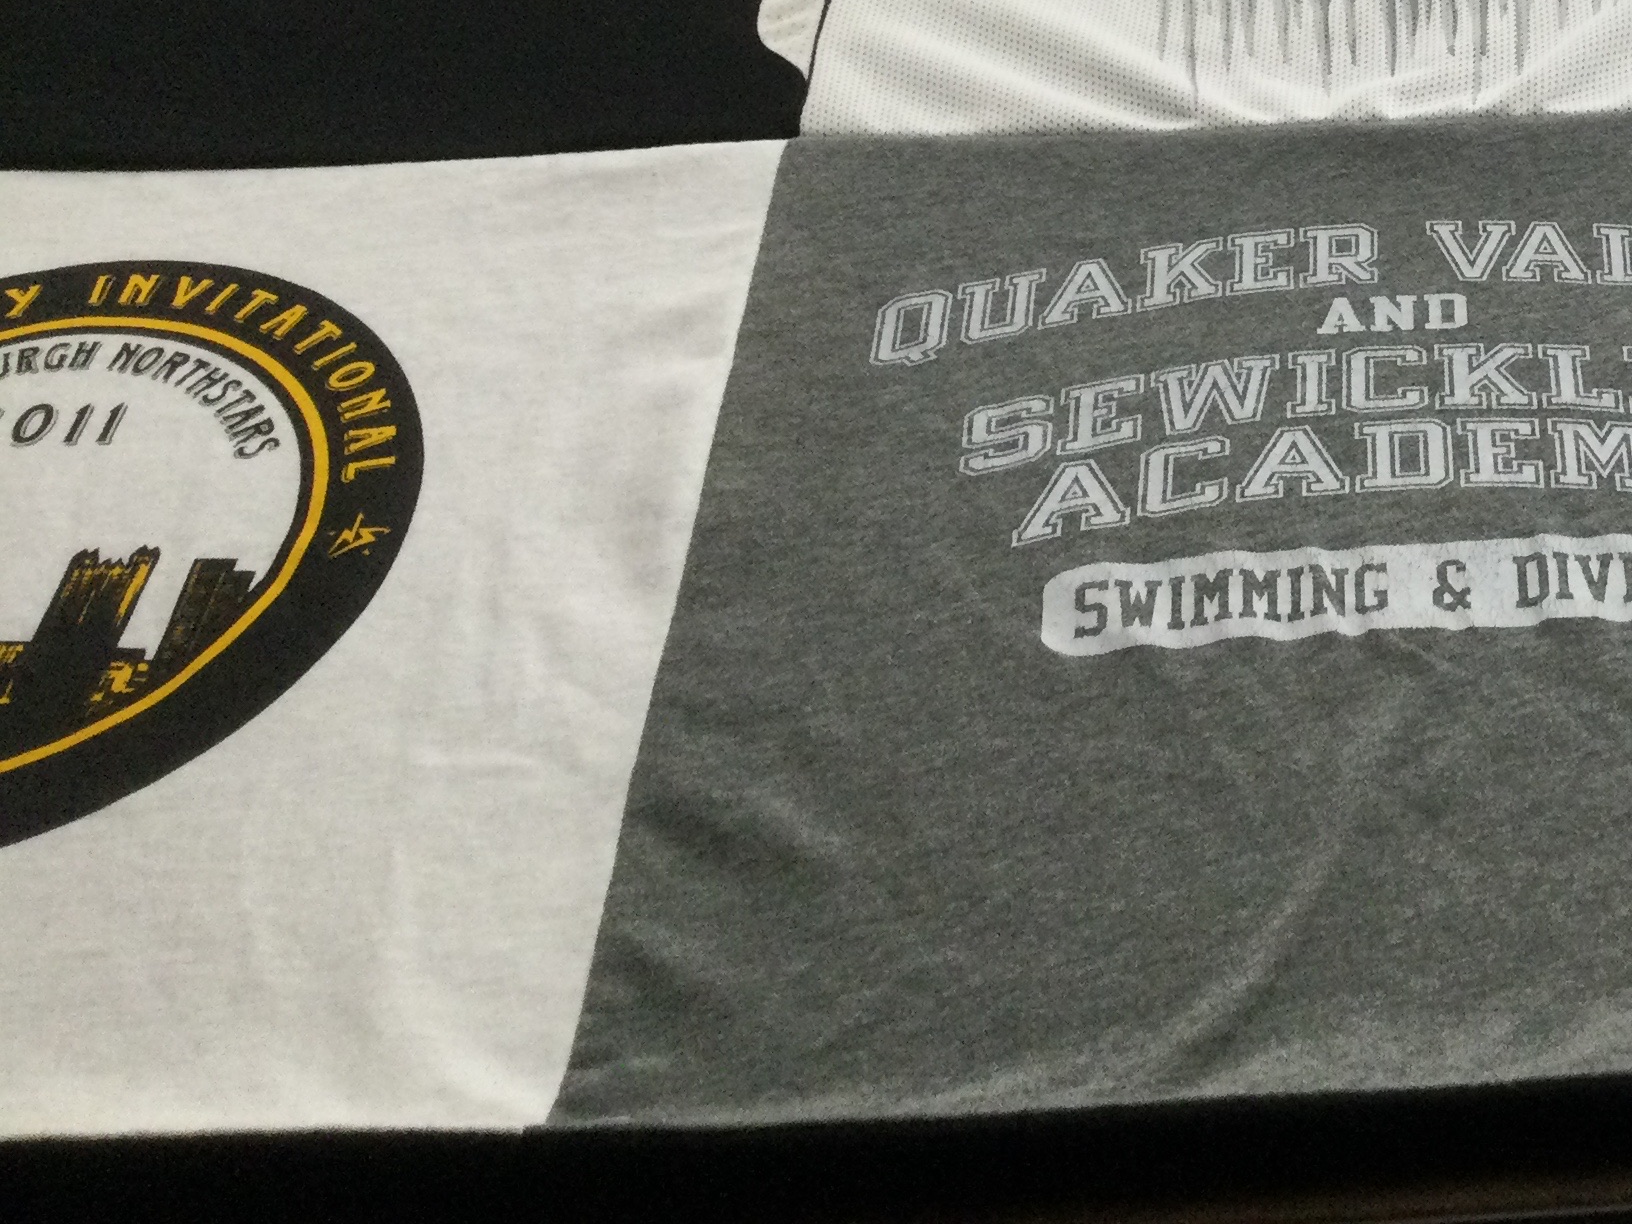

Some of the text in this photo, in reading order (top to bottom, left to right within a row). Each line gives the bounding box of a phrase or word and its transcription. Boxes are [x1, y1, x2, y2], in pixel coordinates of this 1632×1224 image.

[869, 222, 1381, 368] QUAKER
[1316, 291, 1468, 336] AND
[0, 402, 129, 447] 011
[87, 273, 398, 484] INVITATIONAL
[107, 342, 281, 461] NORTHSTARS
[1073, 563, 1391, 640] SWIMMING
[1432, 560, 1475, 612] &
